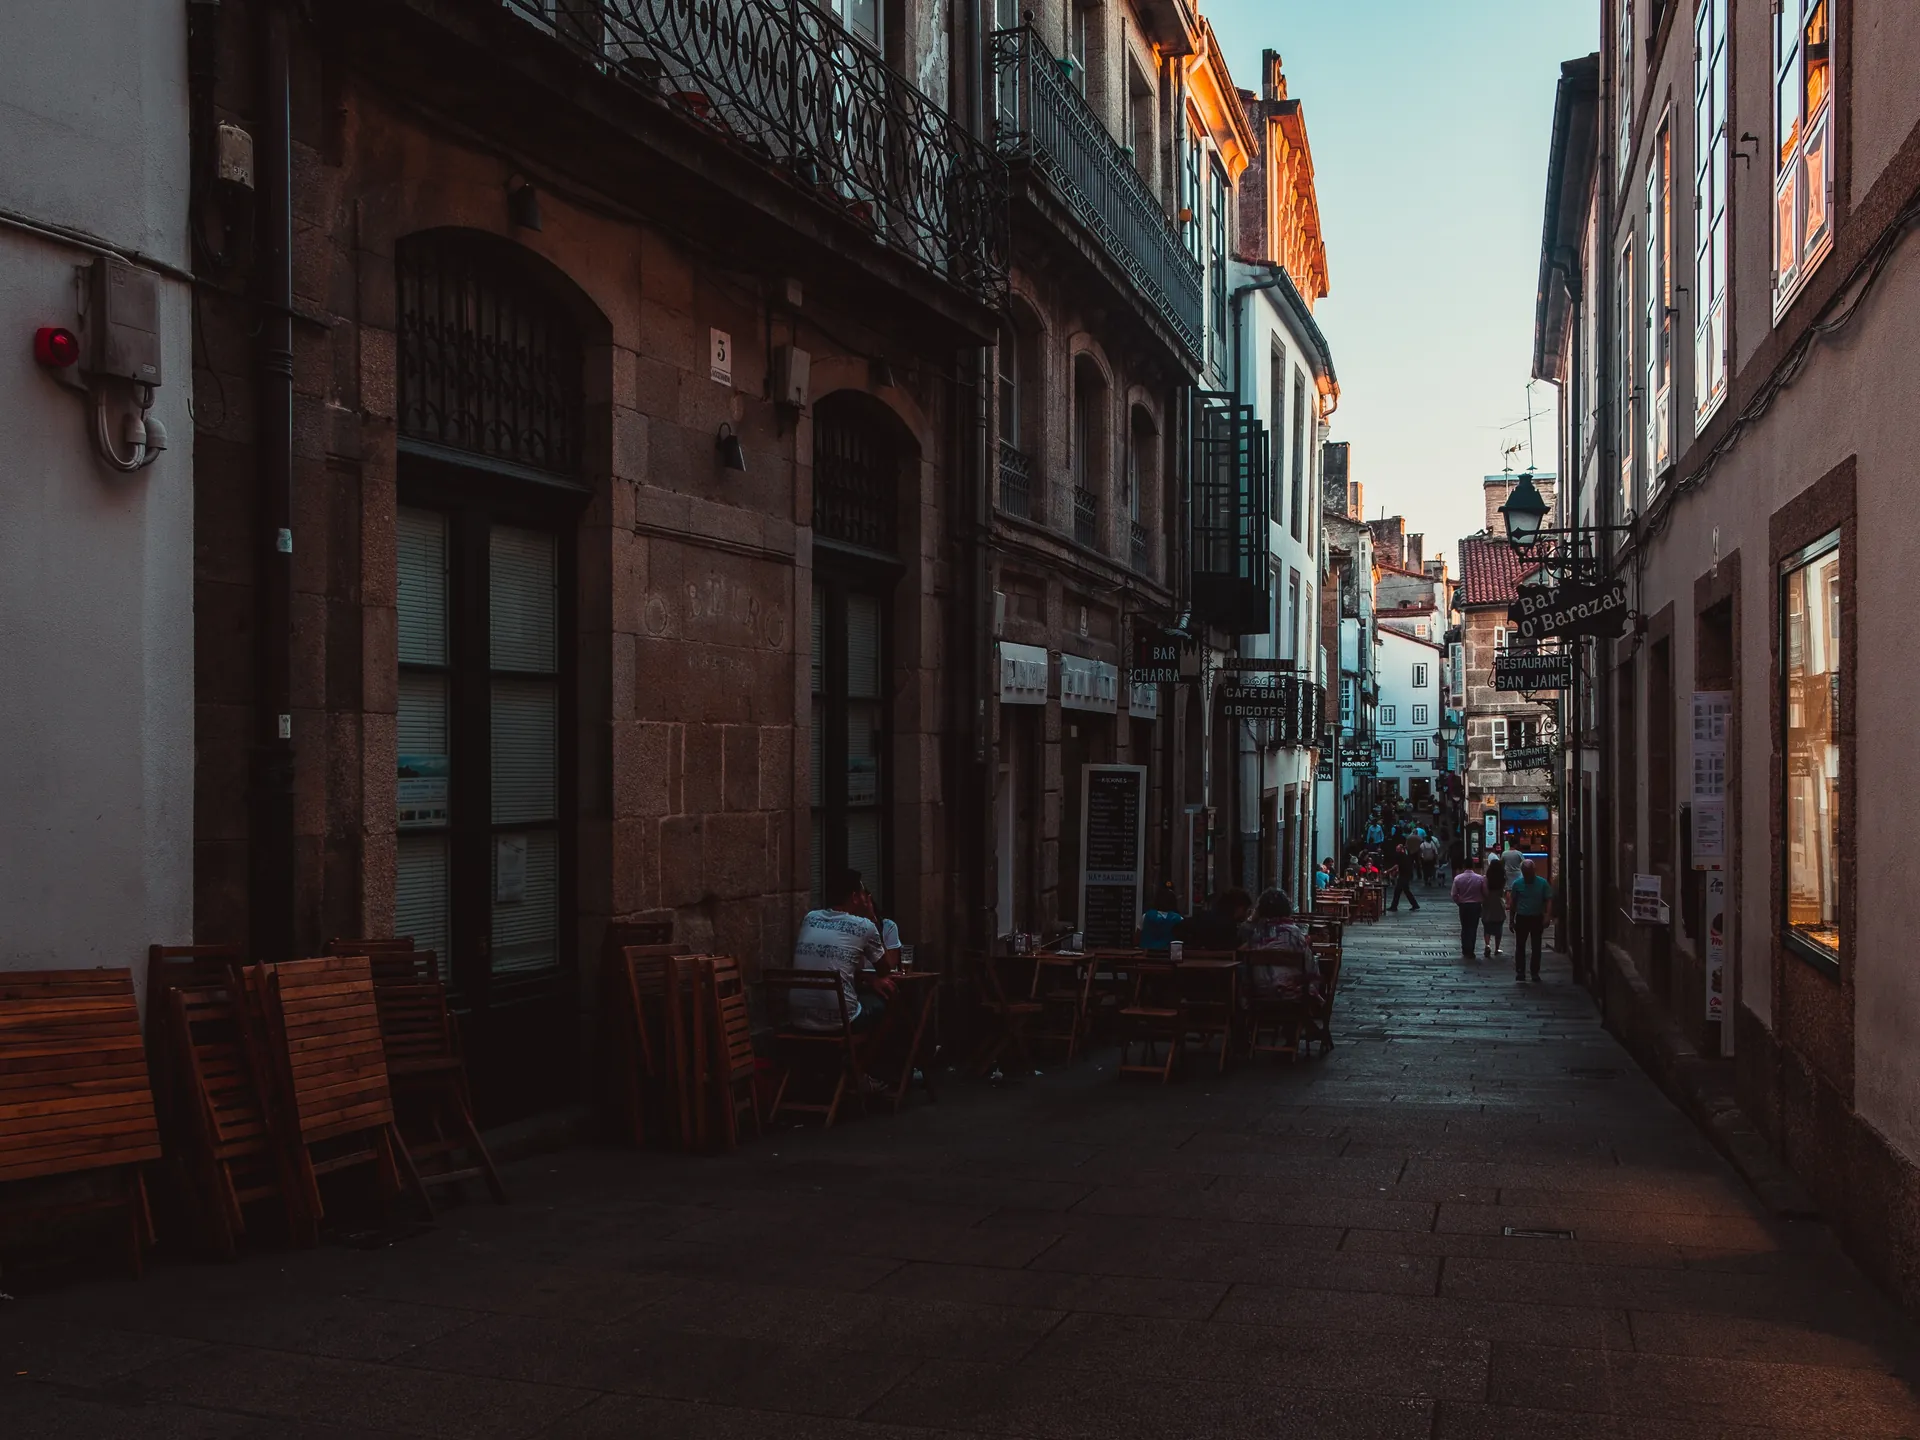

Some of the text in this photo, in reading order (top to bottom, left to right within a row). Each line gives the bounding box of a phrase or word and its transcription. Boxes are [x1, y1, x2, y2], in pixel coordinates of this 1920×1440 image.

[1520, 589, 1560, 616] Bar
[1153, 647, 1176, 660] BAR
[1223, 658, 1293, 670] RESTAURANTE
[1497, 656, 1569, 670] RESTAURANTE
[1497, 673, 1569, 689] SAN JAIME
[1226, 688, 1284, 699] CAFE BAR
[1505, 746, 1548, 758] RESTAURANTE
[1508, 757, 1548, 769] SAN JAIME
